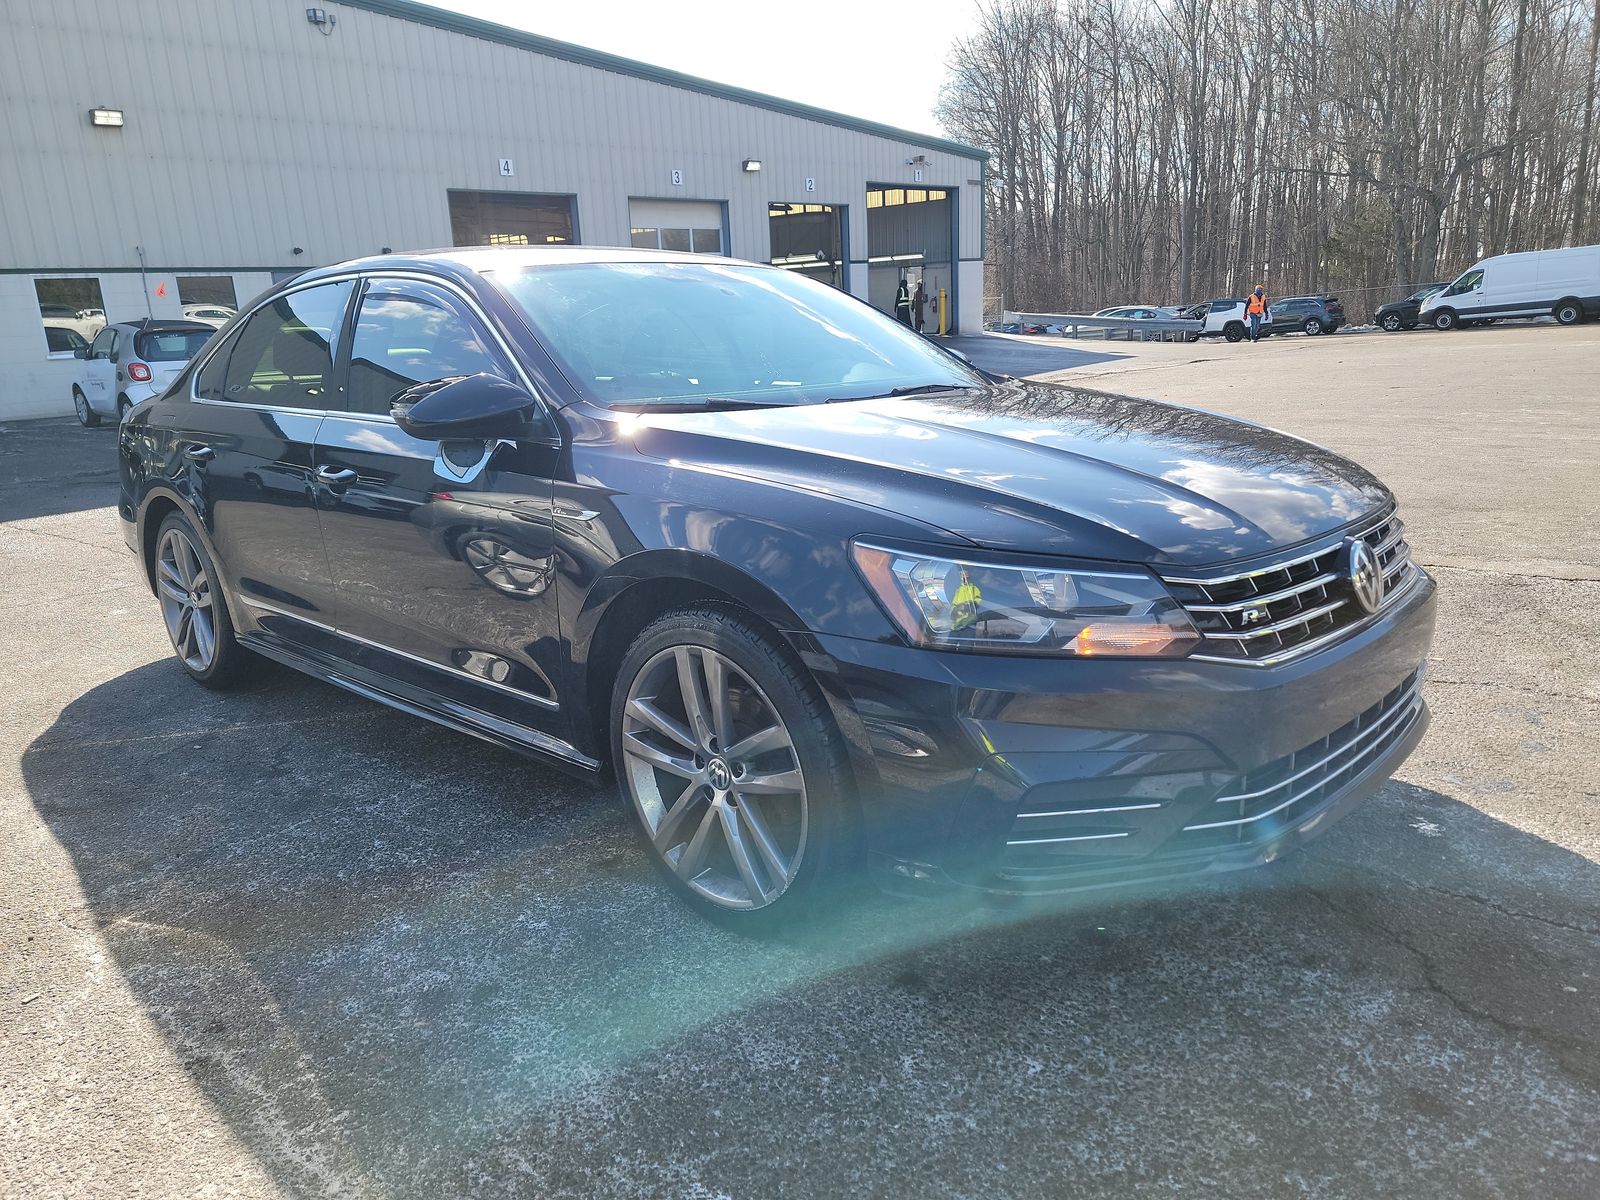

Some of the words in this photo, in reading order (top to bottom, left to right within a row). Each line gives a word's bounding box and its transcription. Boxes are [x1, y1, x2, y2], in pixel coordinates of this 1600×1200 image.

[503, 160, 510, 174] 4
[674, 171, 680, 184] 3
[807, 179, 813, 190] 2
